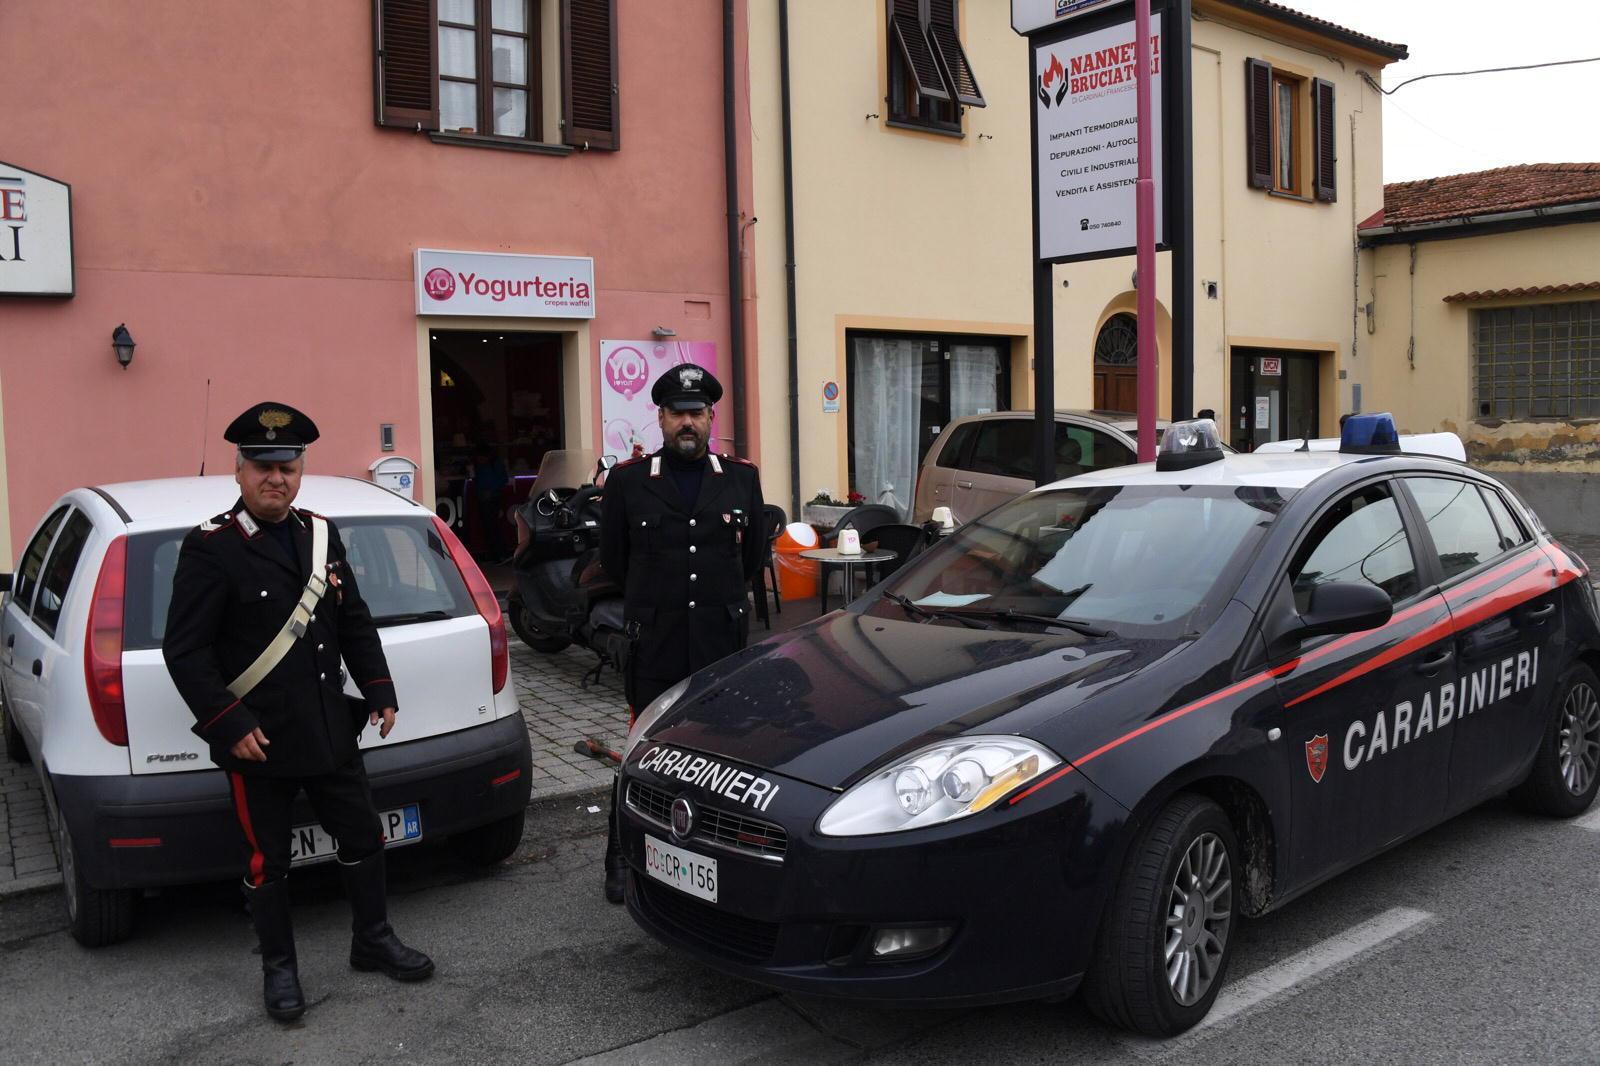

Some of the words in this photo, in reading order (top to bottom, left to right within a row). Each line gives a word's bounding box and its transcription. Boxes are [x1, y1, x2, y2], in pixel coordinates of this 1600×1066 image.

[1070, 35, 1160, 76] NANNETI
[1070, 57, 1160, 95] BRUCIATI
[1050, 129, 1082, 141] IMPIANTI
[1084, 117, 1138, 134] TERMOIDRAUL
[1050, 145, 1101, 160] DEPURAZIONI
[1106, 136, 1138, 149] AUTOCL
[1060, 167, 1083, 177] CIVILI
[1056, 187, 1088, 197] VENDITA
[1096, 176, 1140, 190] ASSISTENZ
[458, 272, 591, 302] Yogurteria
[608, 357, 645, 380] YO!
[1343, 646, 1539, 771] CARABINIERI
[146, 752, 199, 764] Punto
[638, 746, 780, 812] CARABINIERI
[407, 820, 418, 835] AR
[689, 862, 715, 892] 156
